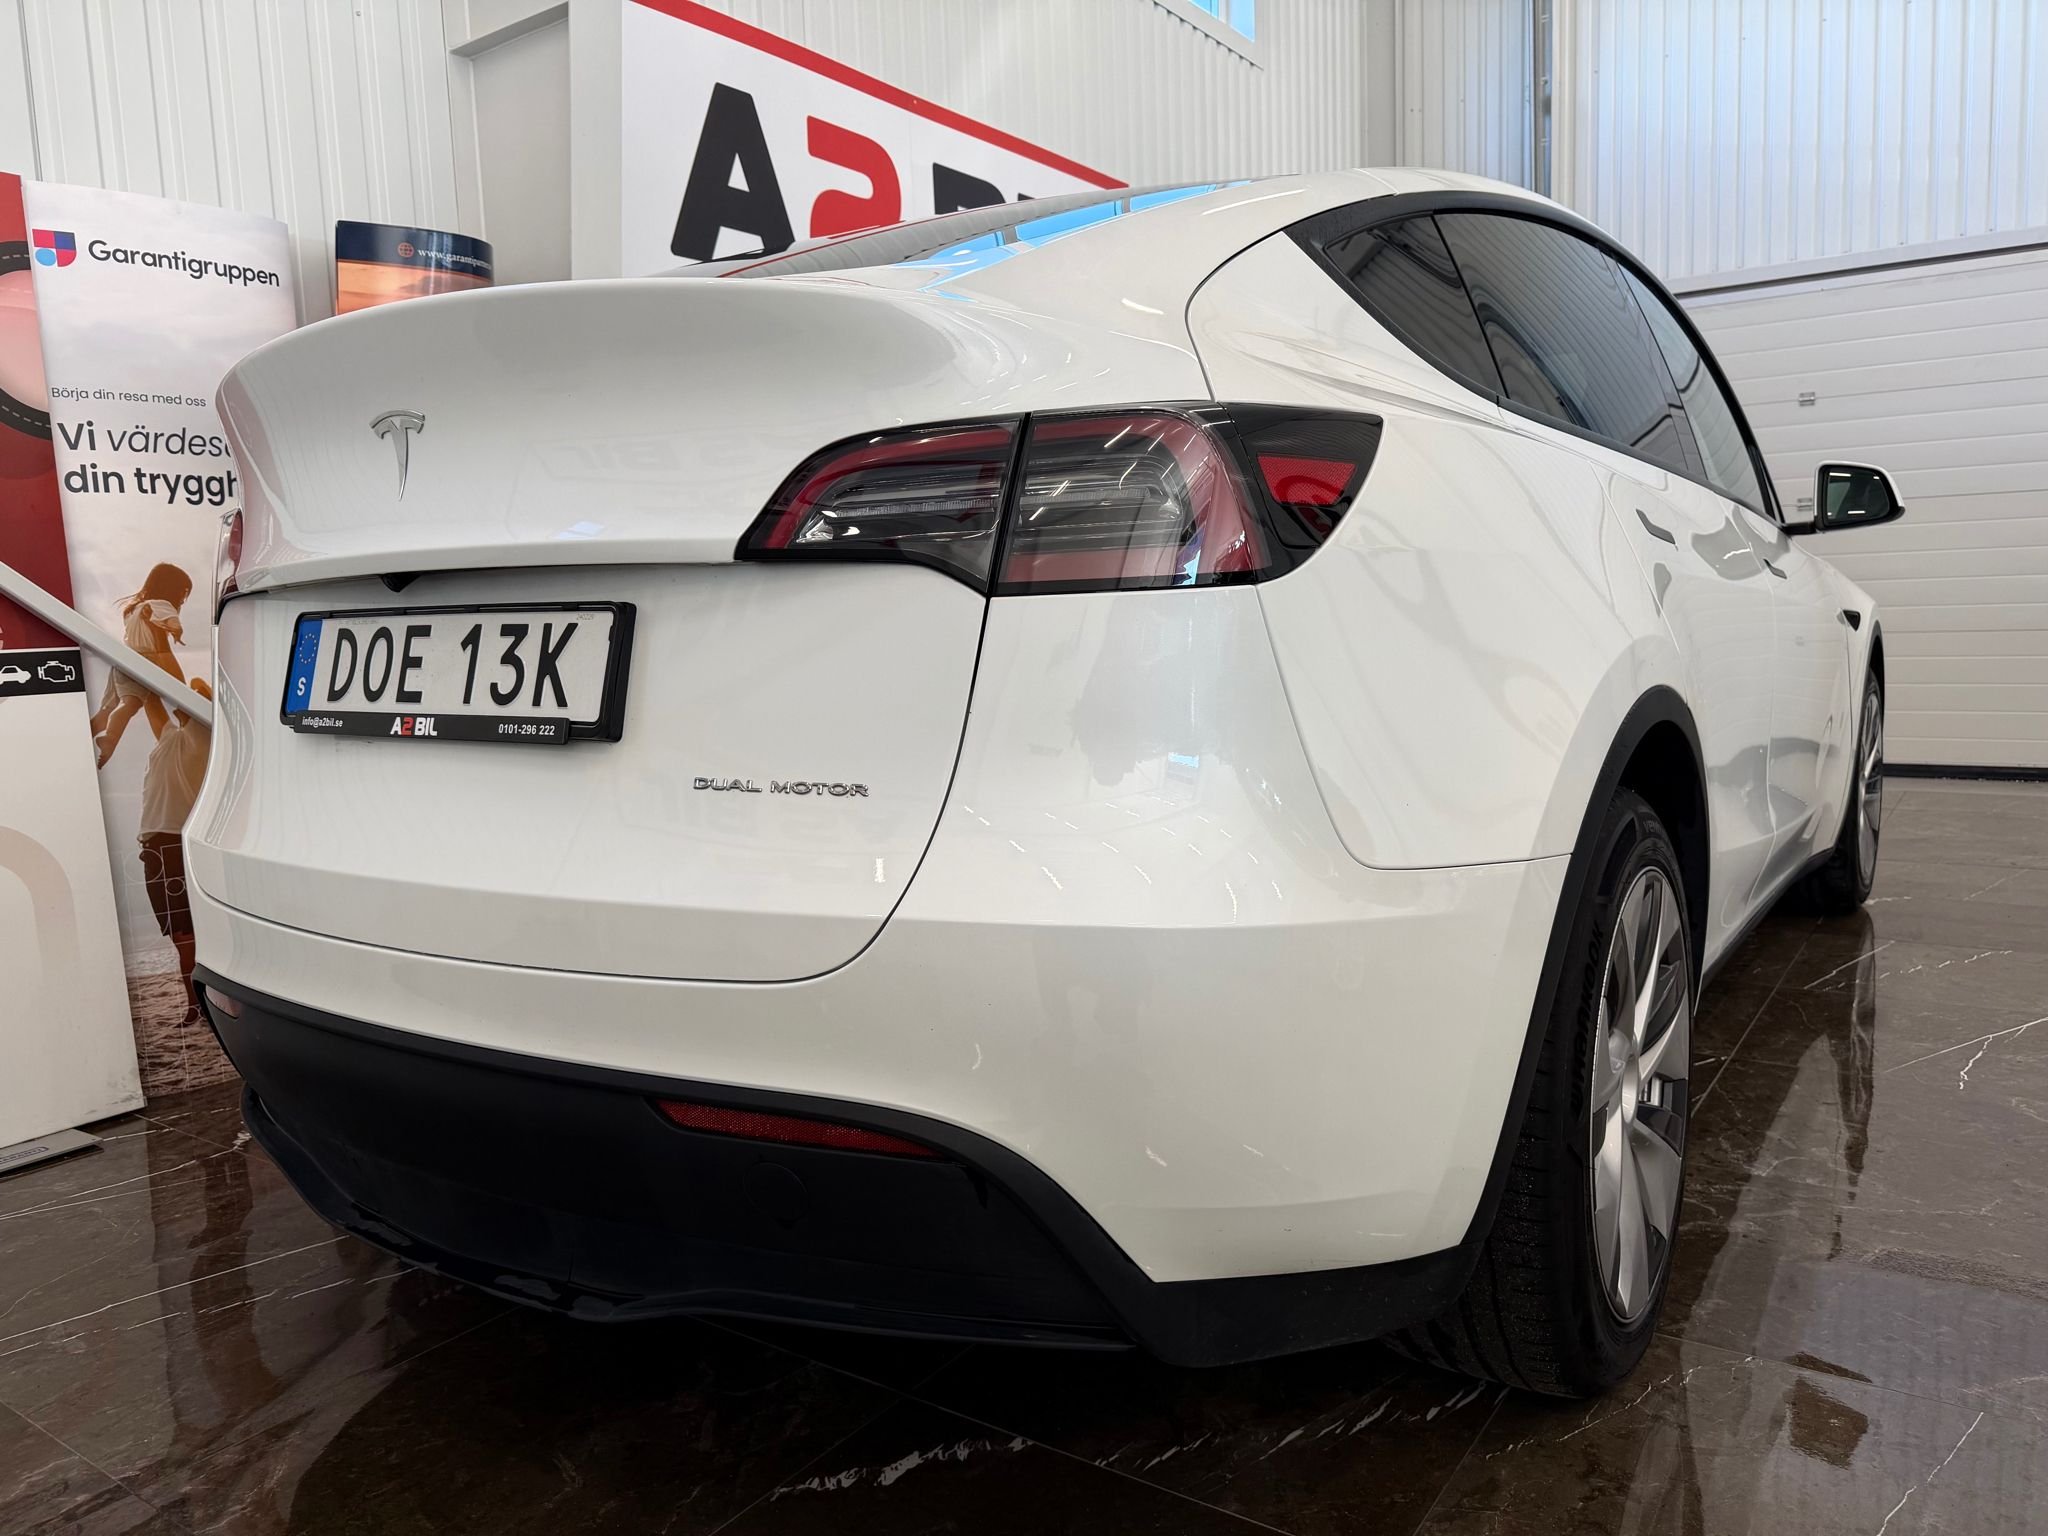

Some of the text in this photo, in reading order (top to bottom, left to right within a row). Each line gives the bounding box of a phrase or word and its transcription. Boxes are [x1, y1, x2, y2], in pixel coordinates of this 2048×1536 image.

[88, 239, 280, 287] Garantigruppen
[51, 387, 206, 407] Börja din resa med oss
[57, 420, 96, 451] Vi
[64, 463, 125, 494] din
[296, 622, 579, 708] S DOE 13K
[301, 716, 343, 728] info@a2bil.se
[498, 724, 537, 735] 0101-296
[539, 725, 555, 736] 222
[693, 776, 869, 797] DUAL MOTOR
